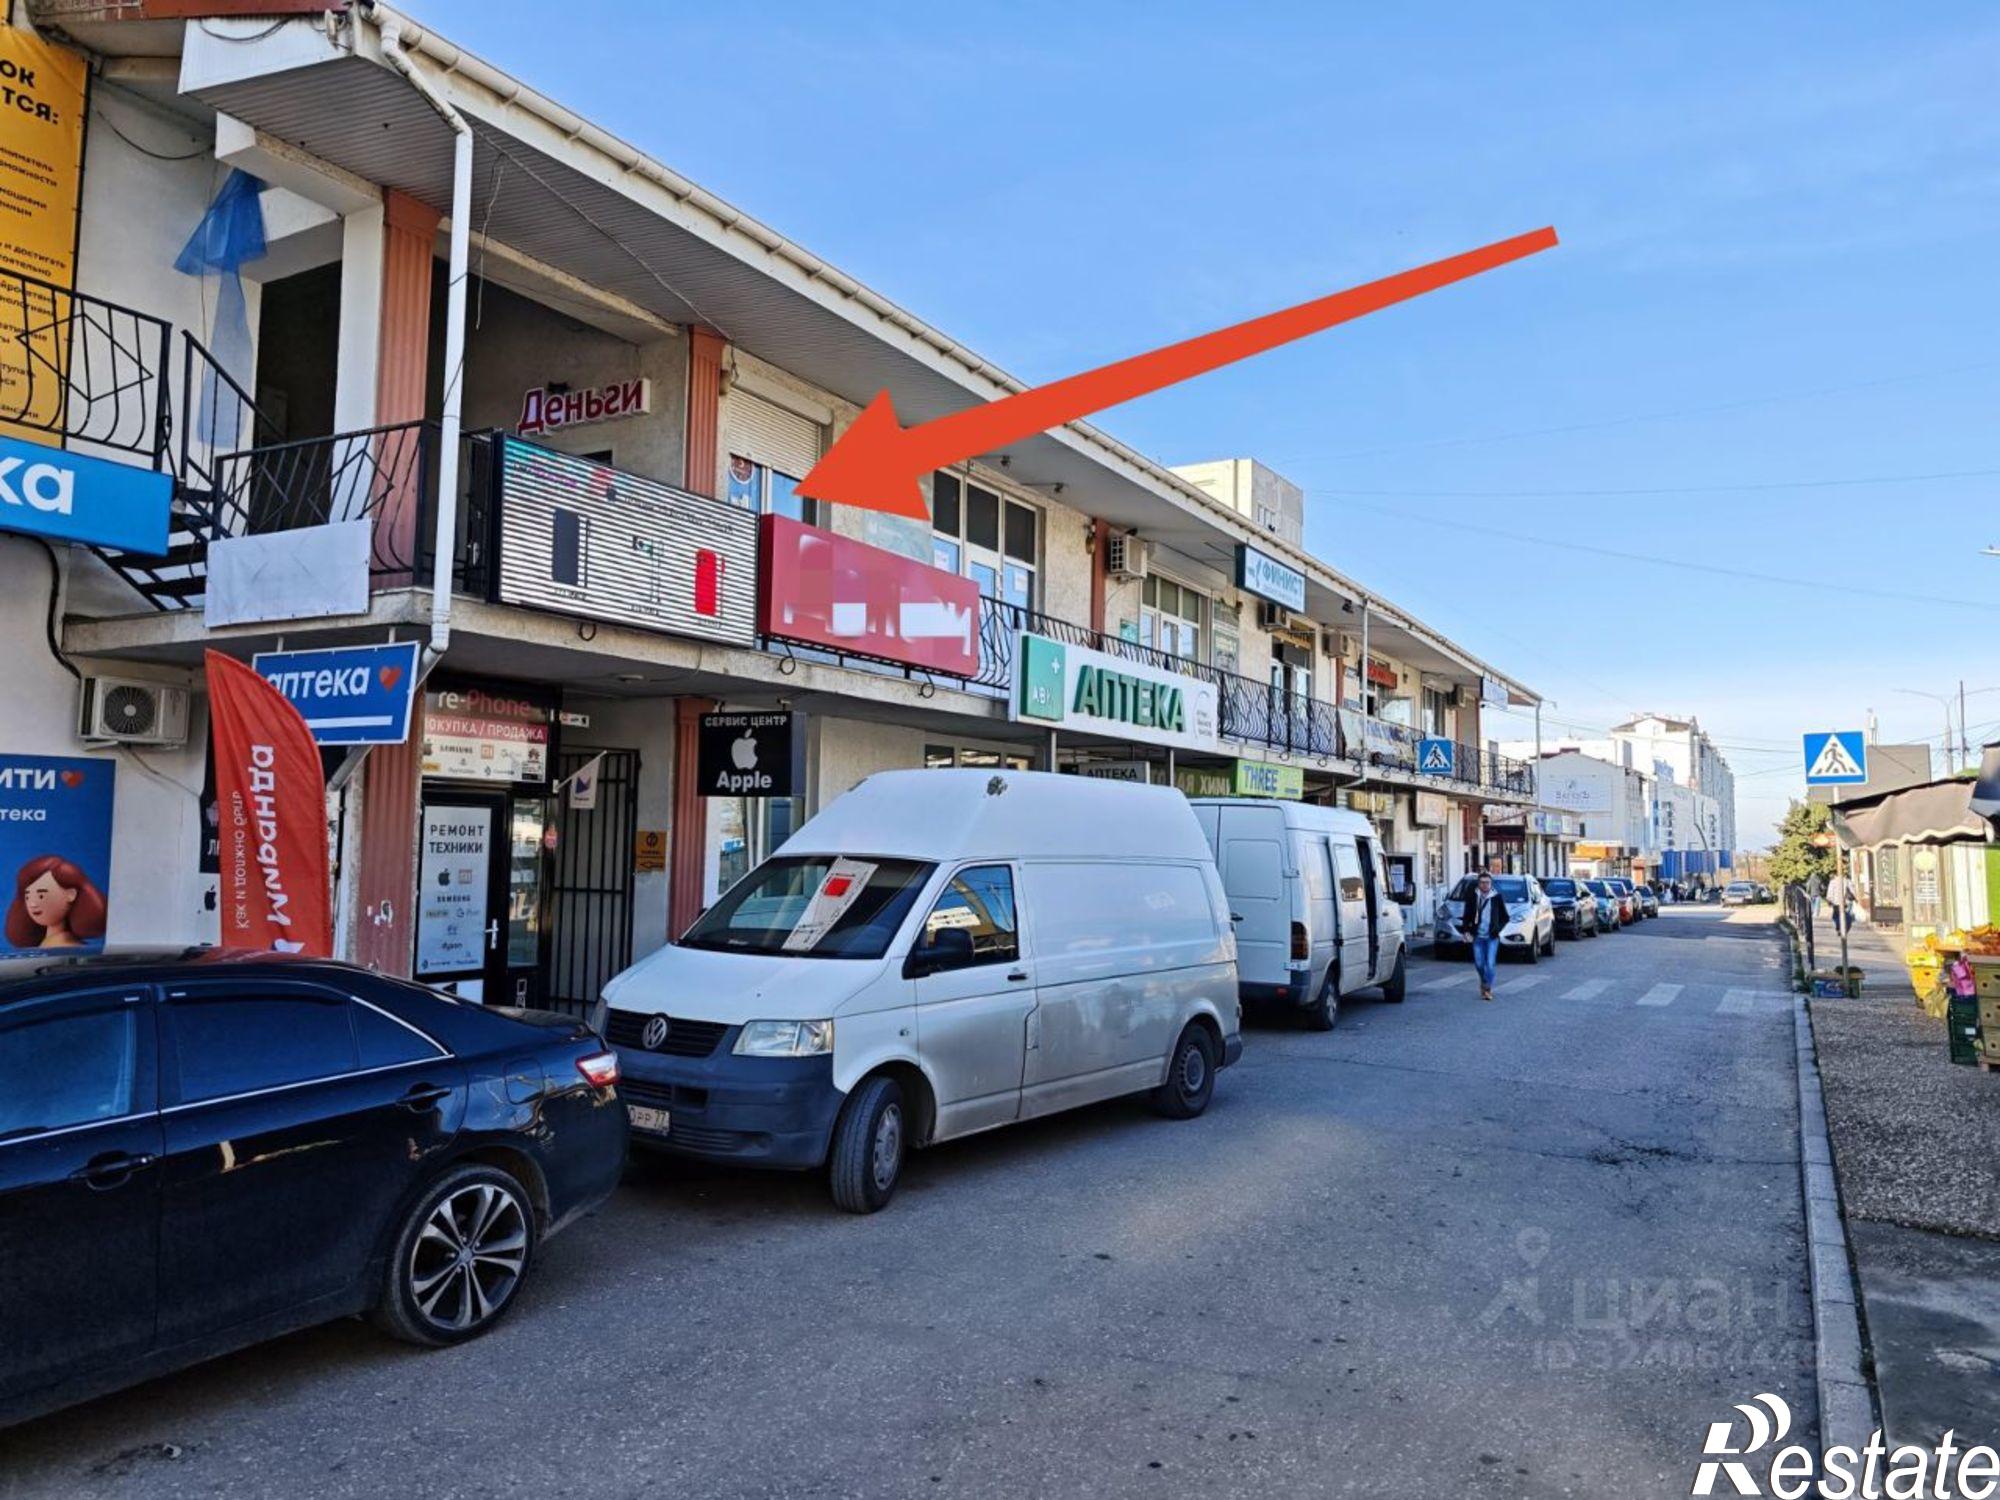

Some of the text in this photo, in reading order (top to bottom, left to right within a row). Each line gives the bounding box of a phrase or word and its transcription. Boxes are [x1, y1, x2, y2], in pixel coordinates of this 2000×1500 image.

[517, 379, 643, 437] Деньги
[438, 690, 531, 718] re-Phone
[1072, 664, 1187, 733] АПТЕКА
[705, 715, 787, 728] СЕРВИС ЦЕНТР
[487, 723, 545, 741] ПРОДАЖА
[716, 770, 773, 793] Apple
[1087, 767, 1137, 780] АПТЕКА
[1243, 765, 1279, 793] THREE
[430, 824, 484, 837] РЕМОНТ
[429, 841, 483, 854] ТЕХНИКИ
